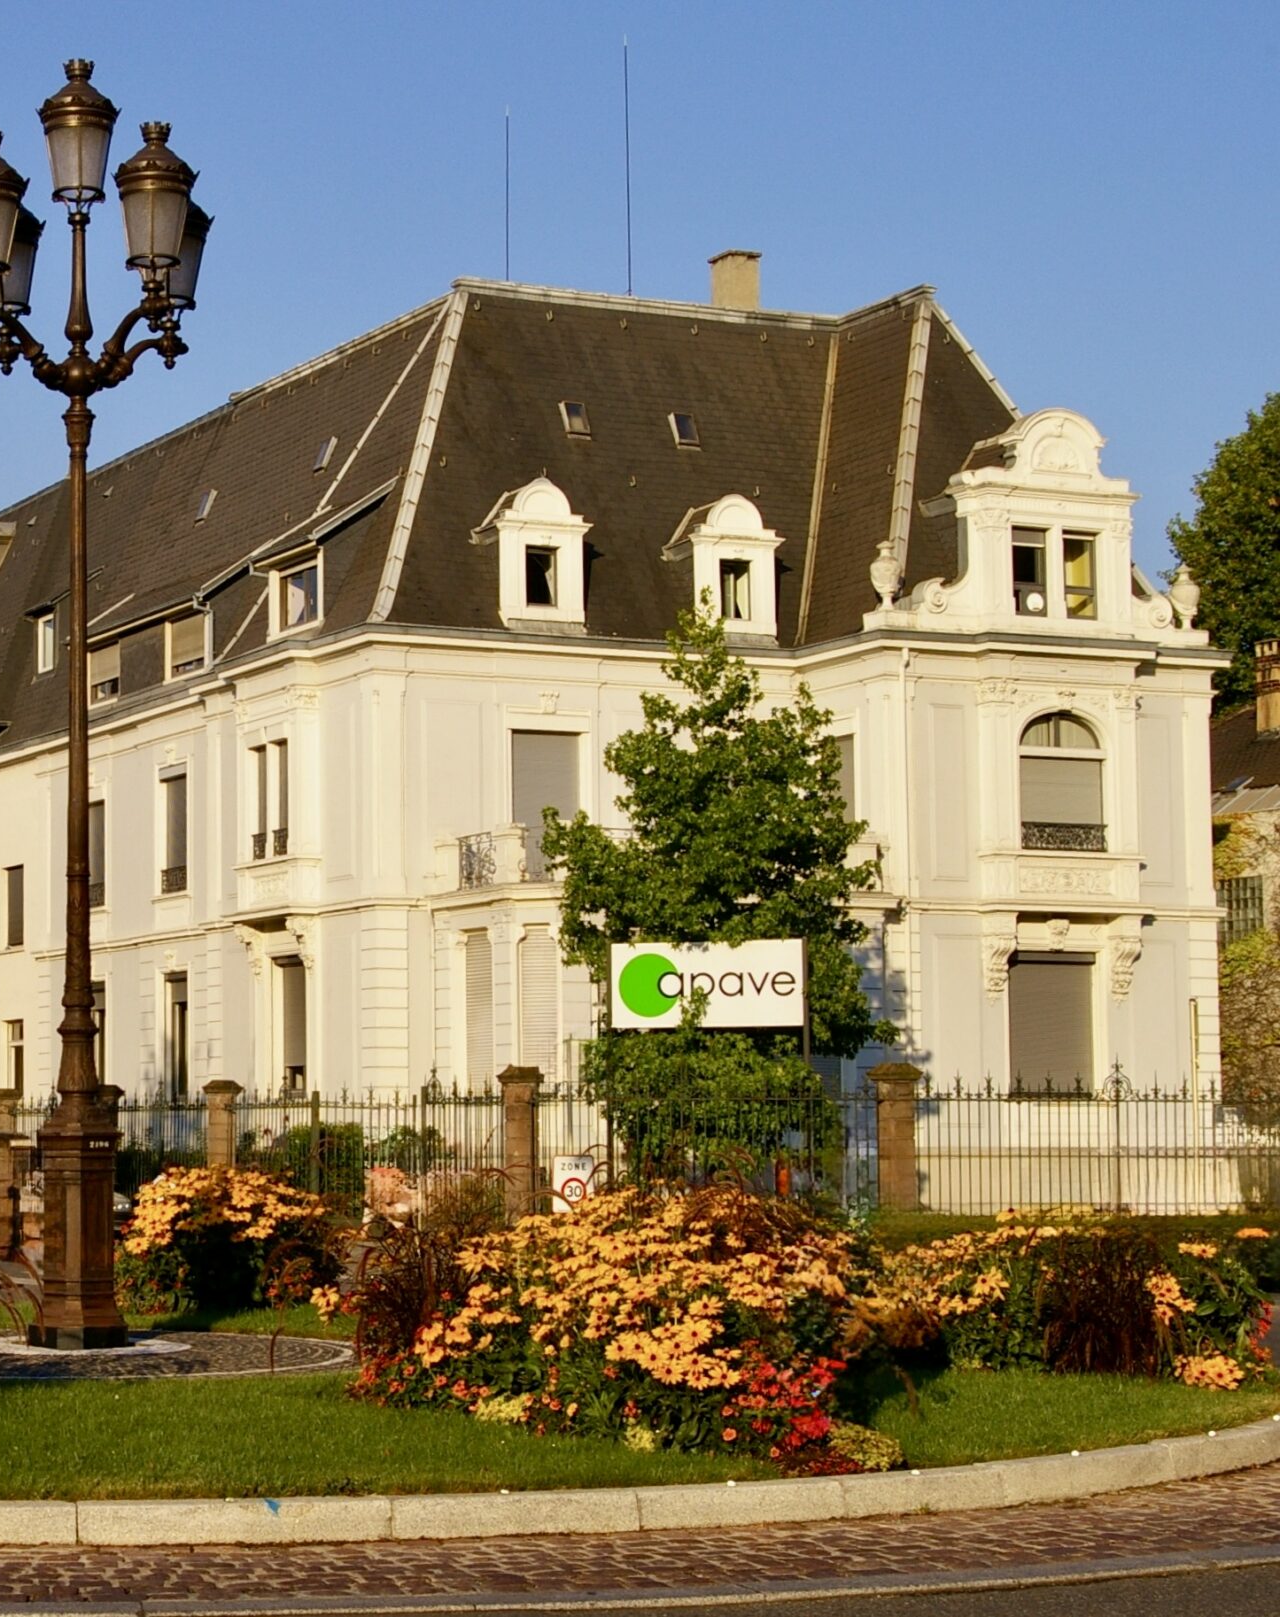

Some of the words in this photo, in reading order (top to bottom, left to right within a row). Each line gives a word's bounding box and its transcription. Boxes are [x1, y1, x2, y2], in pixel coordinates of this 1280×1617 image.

[657, 971, 796, 1003] apave
[561, 1162, 587, 1171] ZONE
[566, 1185, 582, 1198] 30
